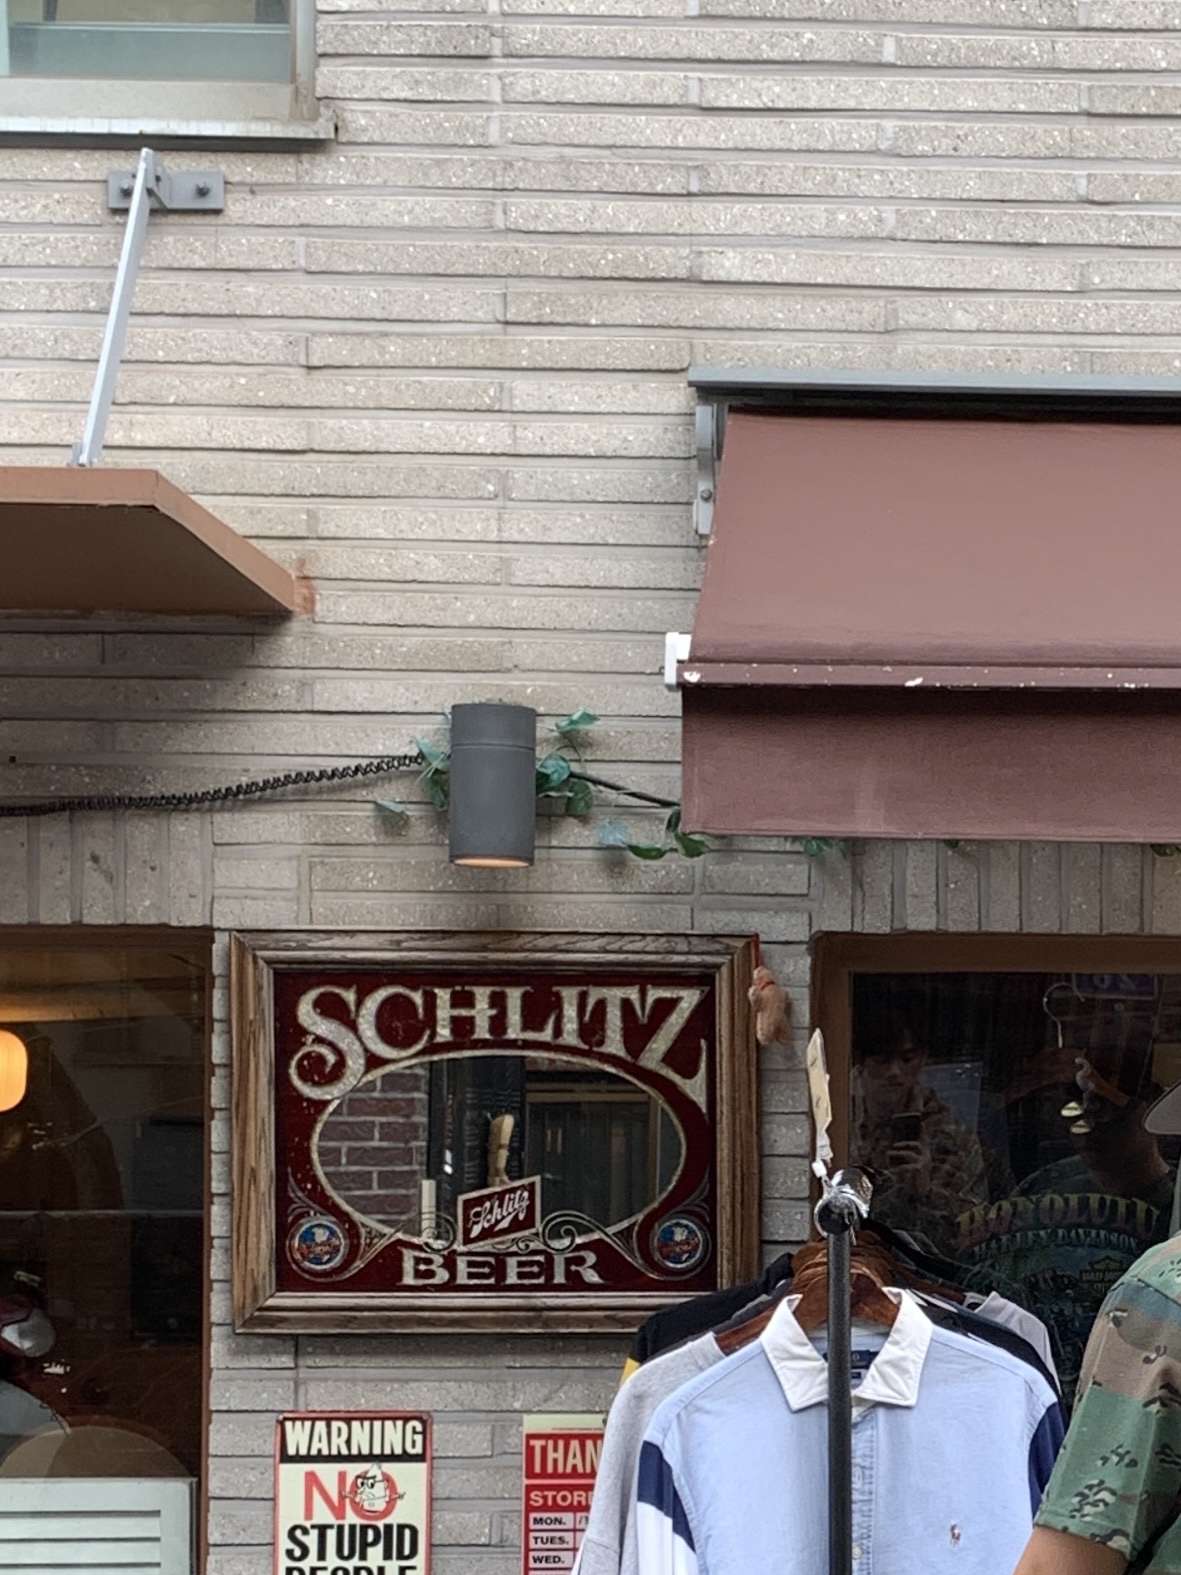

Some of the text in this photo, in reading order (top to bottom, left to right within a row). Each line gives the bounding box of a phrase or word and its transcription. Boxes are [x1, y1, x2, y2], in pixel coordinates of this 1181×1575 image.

[288, 985, 710, 1112] SCHLITZ
[467, 1190, 530, 1238] Schlitz
[399, 1250, 609, 1286] BEER
[285, 1420, 423, 1456] WARNING
[304, 1469, 398, 1521] NO
[533, 1517, 566, 1526] MON.
[285, 1523, 419, 1562] STUPID
[533, 1536, 569, 1545] TUES.
[532, 1555, 565, 1564] WED.
